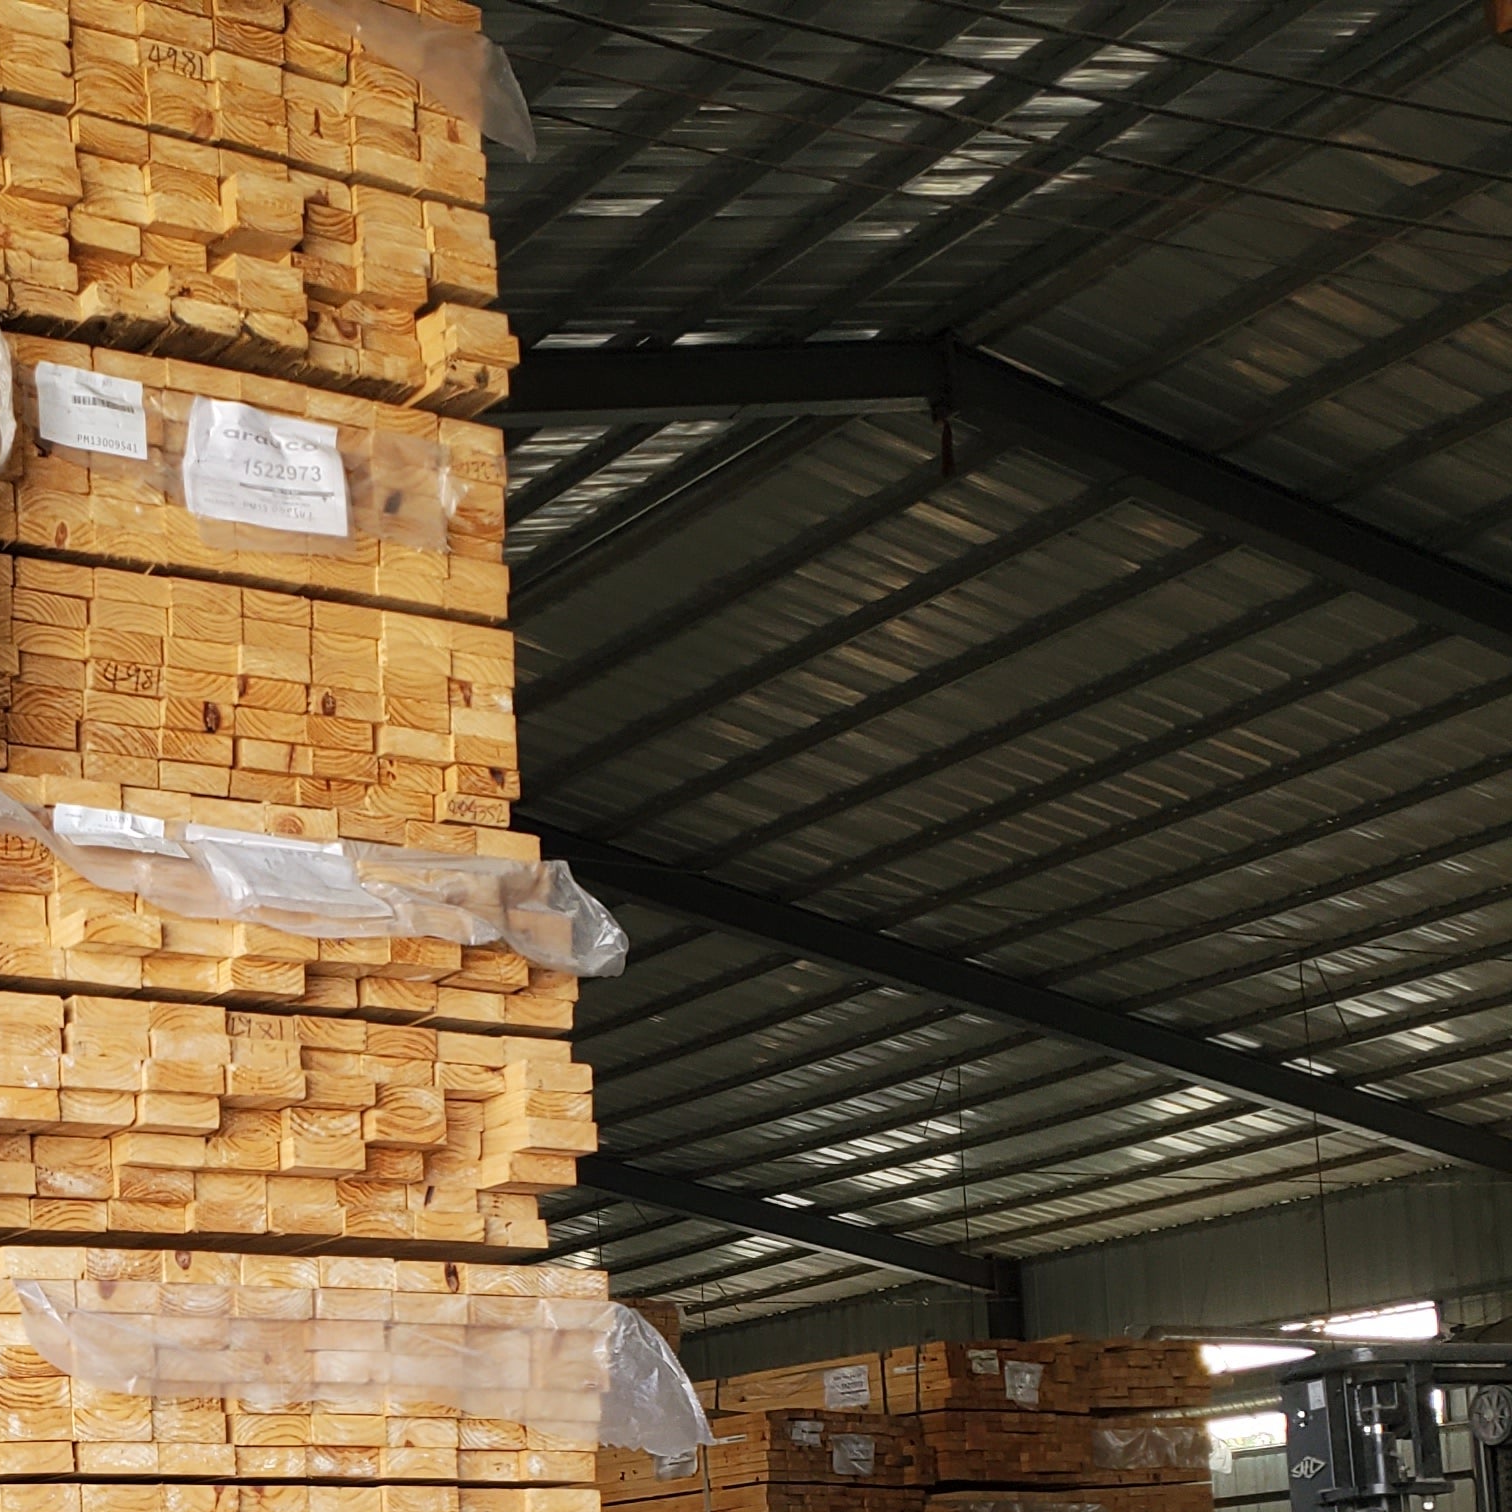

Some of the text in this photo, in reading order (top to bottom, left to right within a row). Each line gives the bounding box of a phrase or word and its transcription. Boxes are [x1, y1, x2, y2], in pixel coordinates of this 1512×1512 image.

[148, 44, 204, 81] 4981
[243, 456, 322, 483] 1522973
[103, 662, 161, 694] 4981
